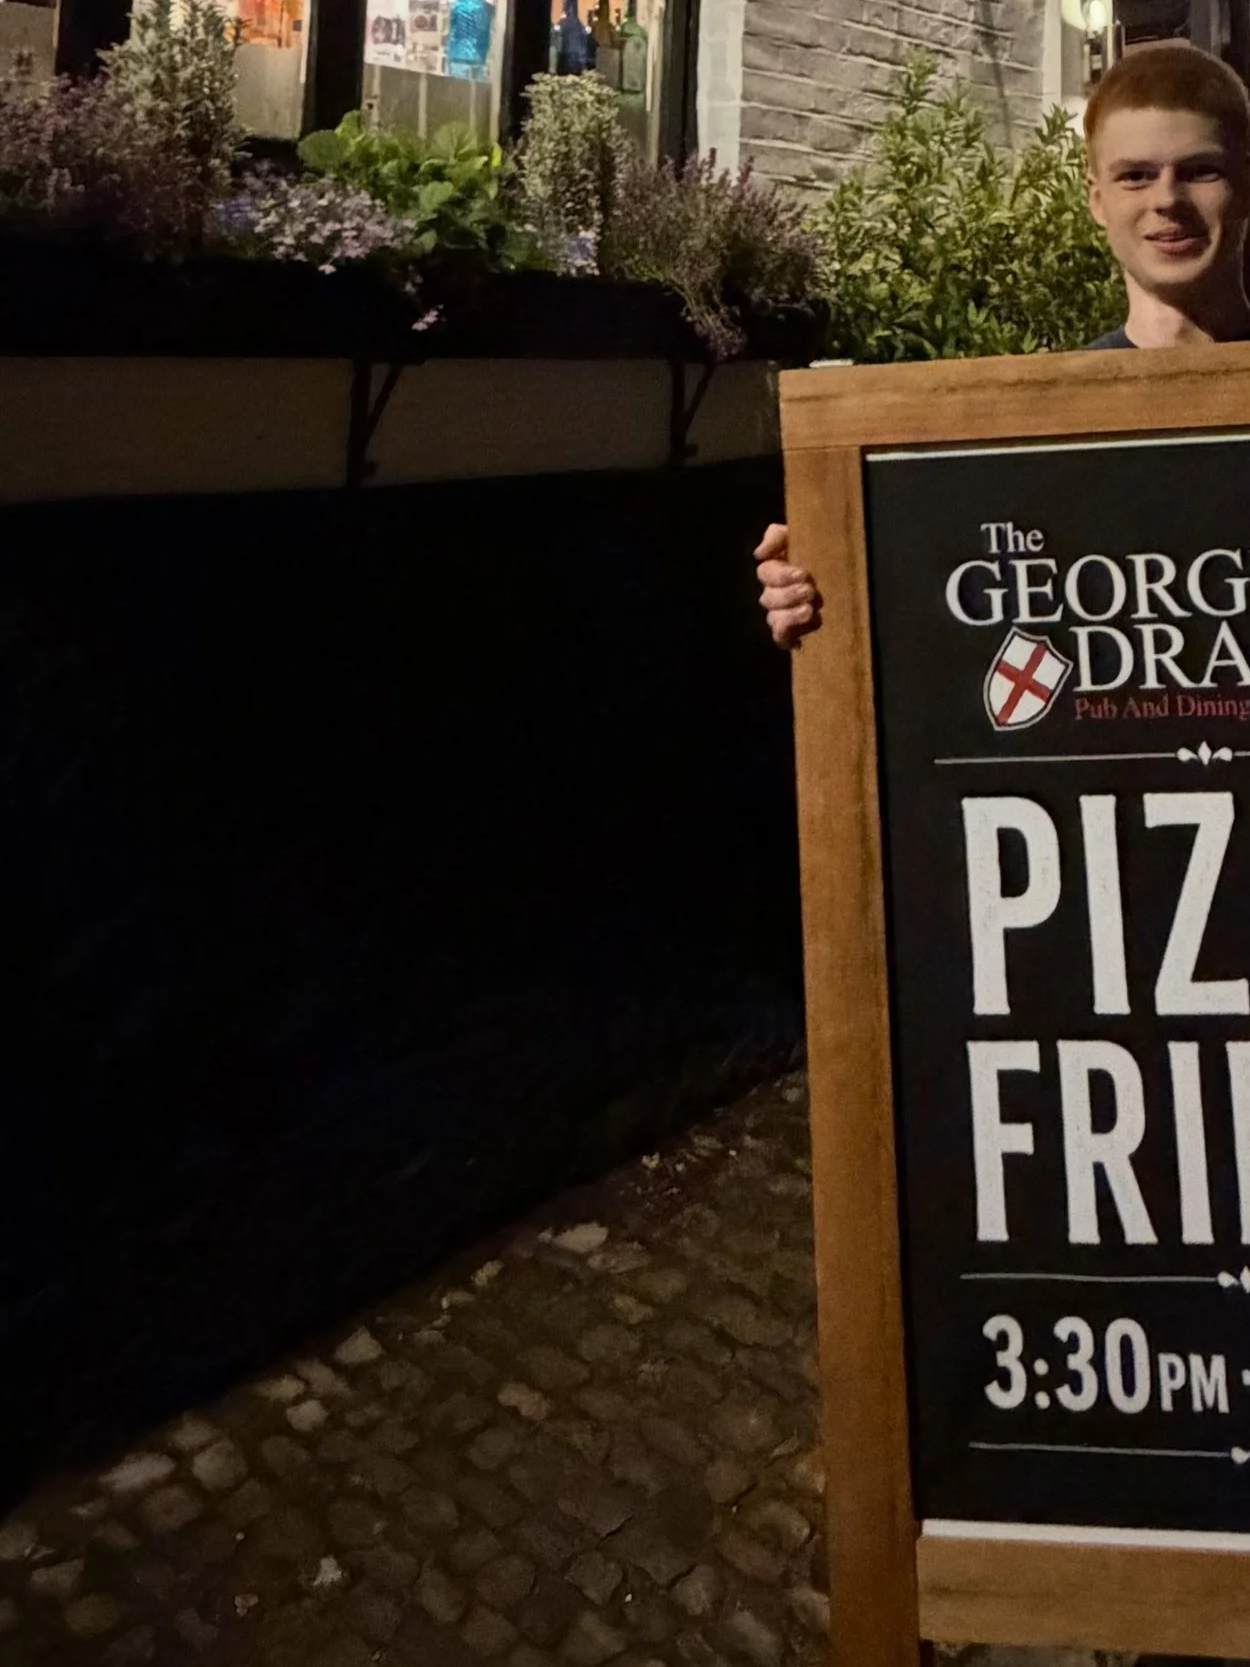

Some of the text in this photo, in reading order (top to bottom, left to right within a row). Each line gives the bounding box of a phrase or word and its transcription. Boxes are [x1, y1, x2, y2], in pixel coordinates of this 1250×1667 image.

[980, 521, 1045, 555] The
[1074, 695, 1118, 720] Pub
[1123, 692, 1170, 719] And
[982, 1314, 1230, 1415] 3:30PM
